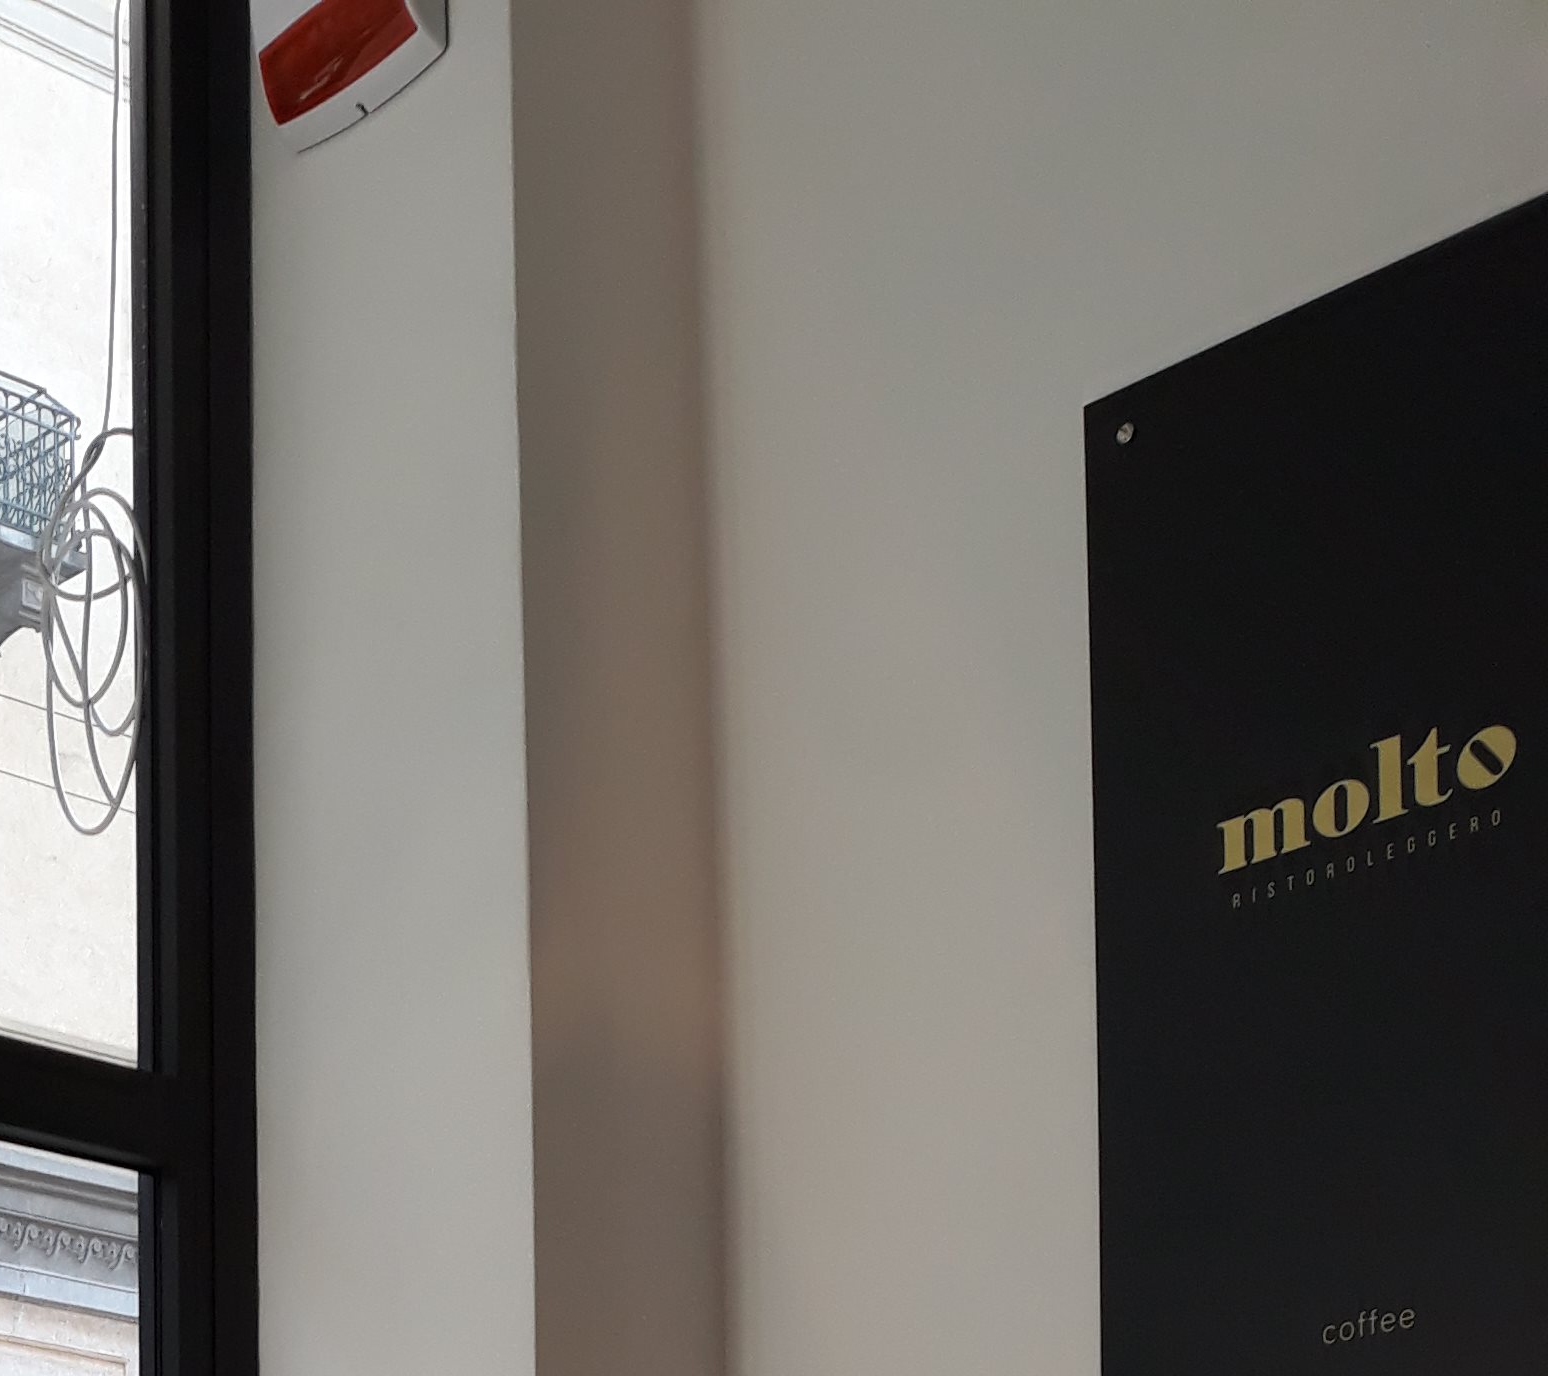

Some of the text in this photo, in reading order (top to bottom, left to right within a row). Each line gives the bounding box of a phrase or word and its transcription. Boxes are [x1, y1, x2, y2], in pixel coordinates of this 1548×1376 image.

[1216, 724, 1518, 875] molto
[1231, 808, 1504, 910] RISTOROLEGGERO
[1320, 1305, 1418, 1346] coffee
